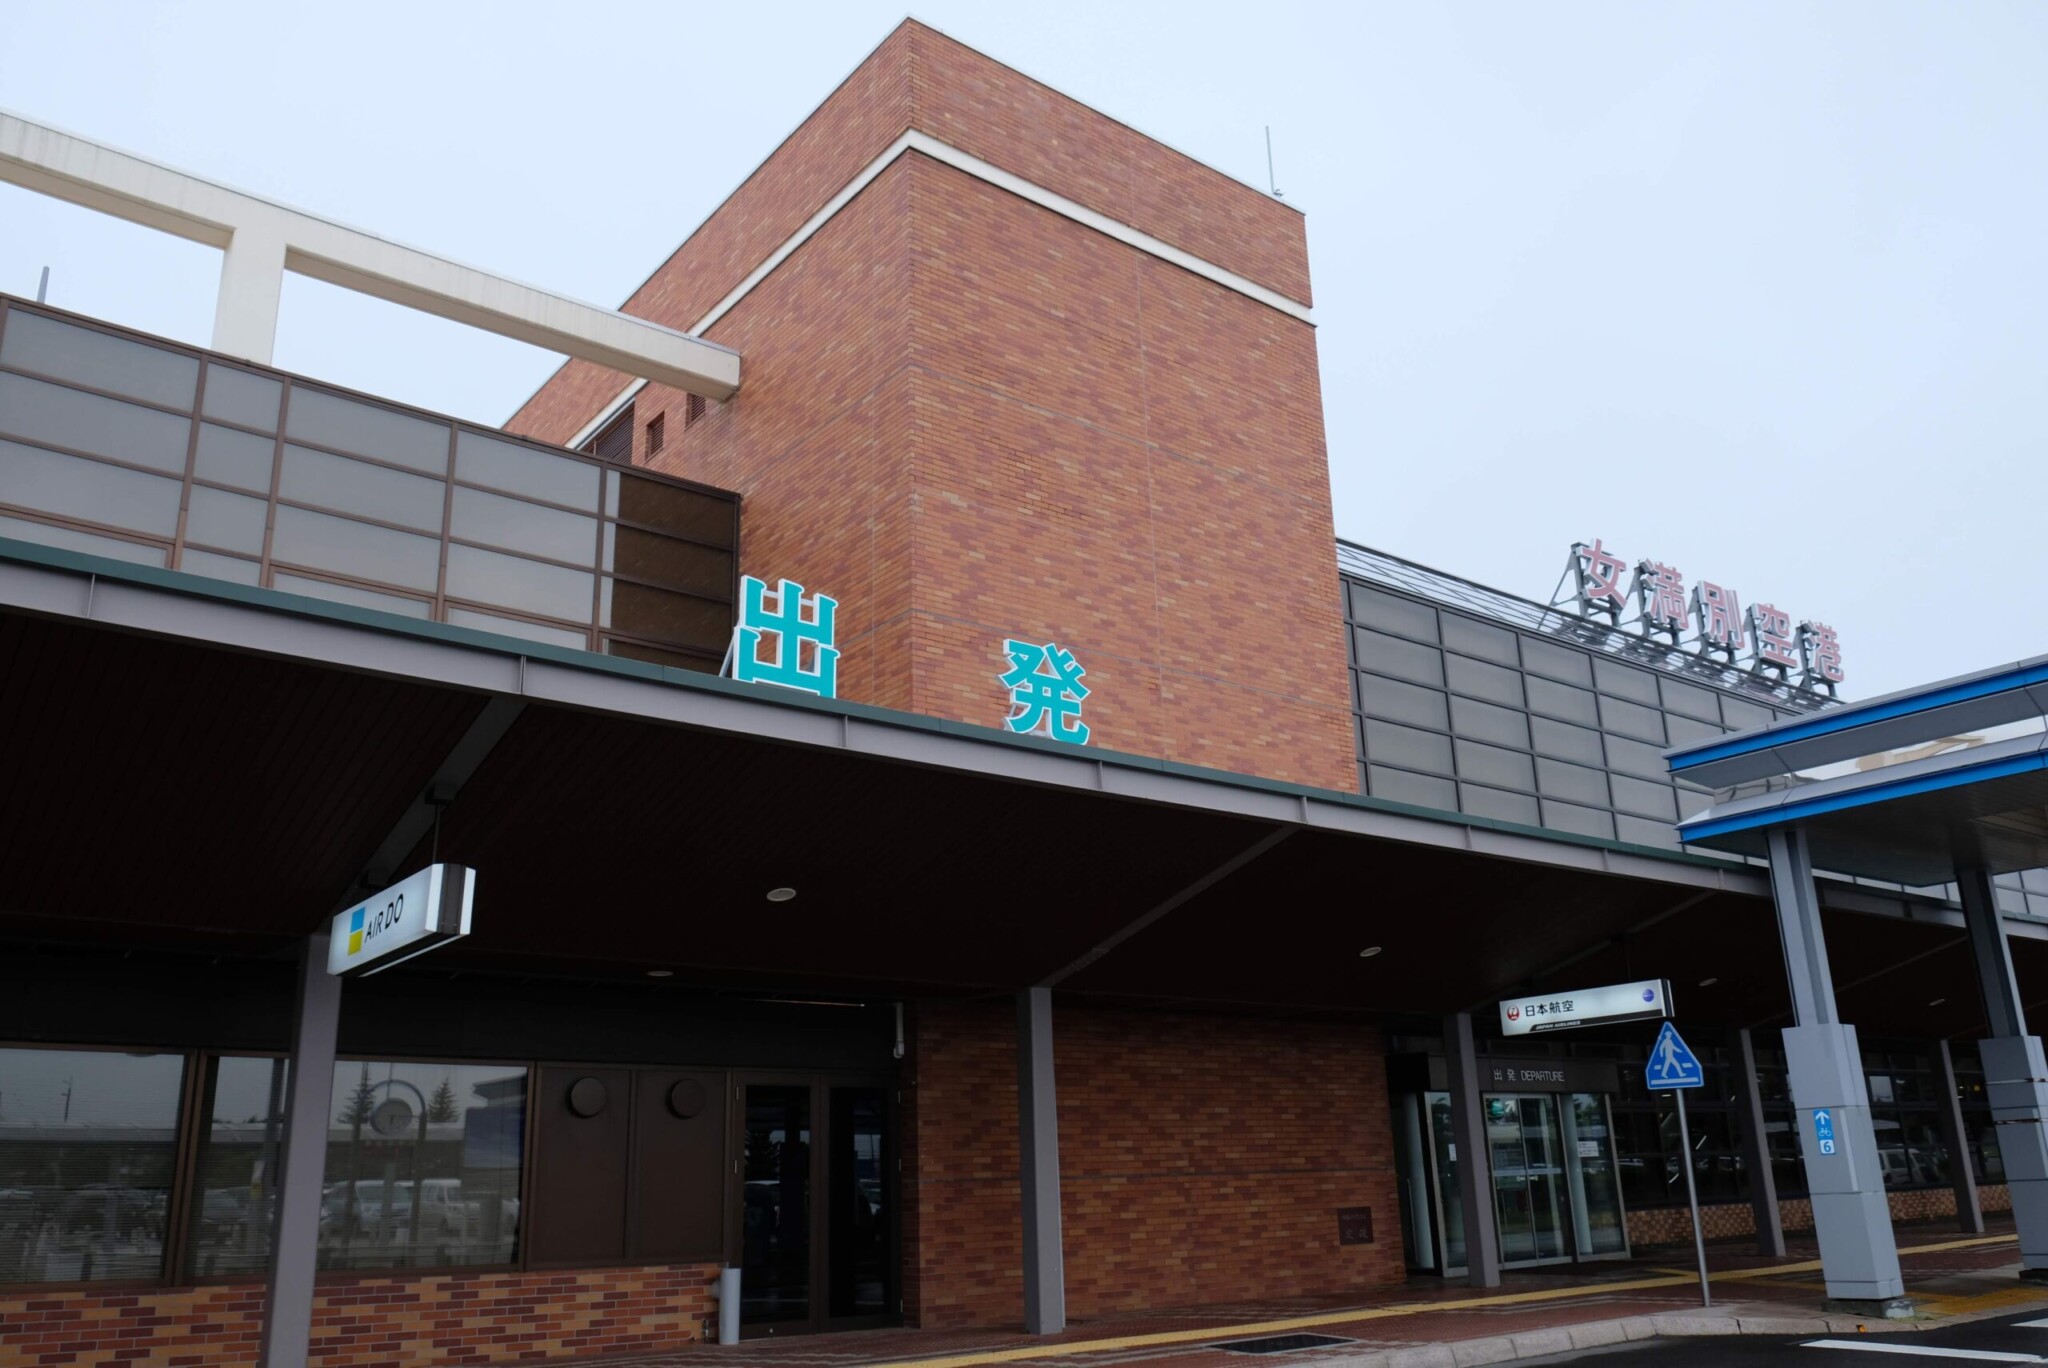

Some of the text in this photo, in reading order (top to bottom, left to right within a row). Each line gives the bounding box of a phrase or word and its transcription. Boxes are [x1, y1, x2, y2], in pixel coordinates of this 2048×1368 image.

[1567, 538, 1844, 682] 女満別空港
[1525, 1000, 1574, 1017] 日本航空
[1520, 1070, 1565, 1082] DEPARTURE
[1823, 1141, 1831, 1152] 6
